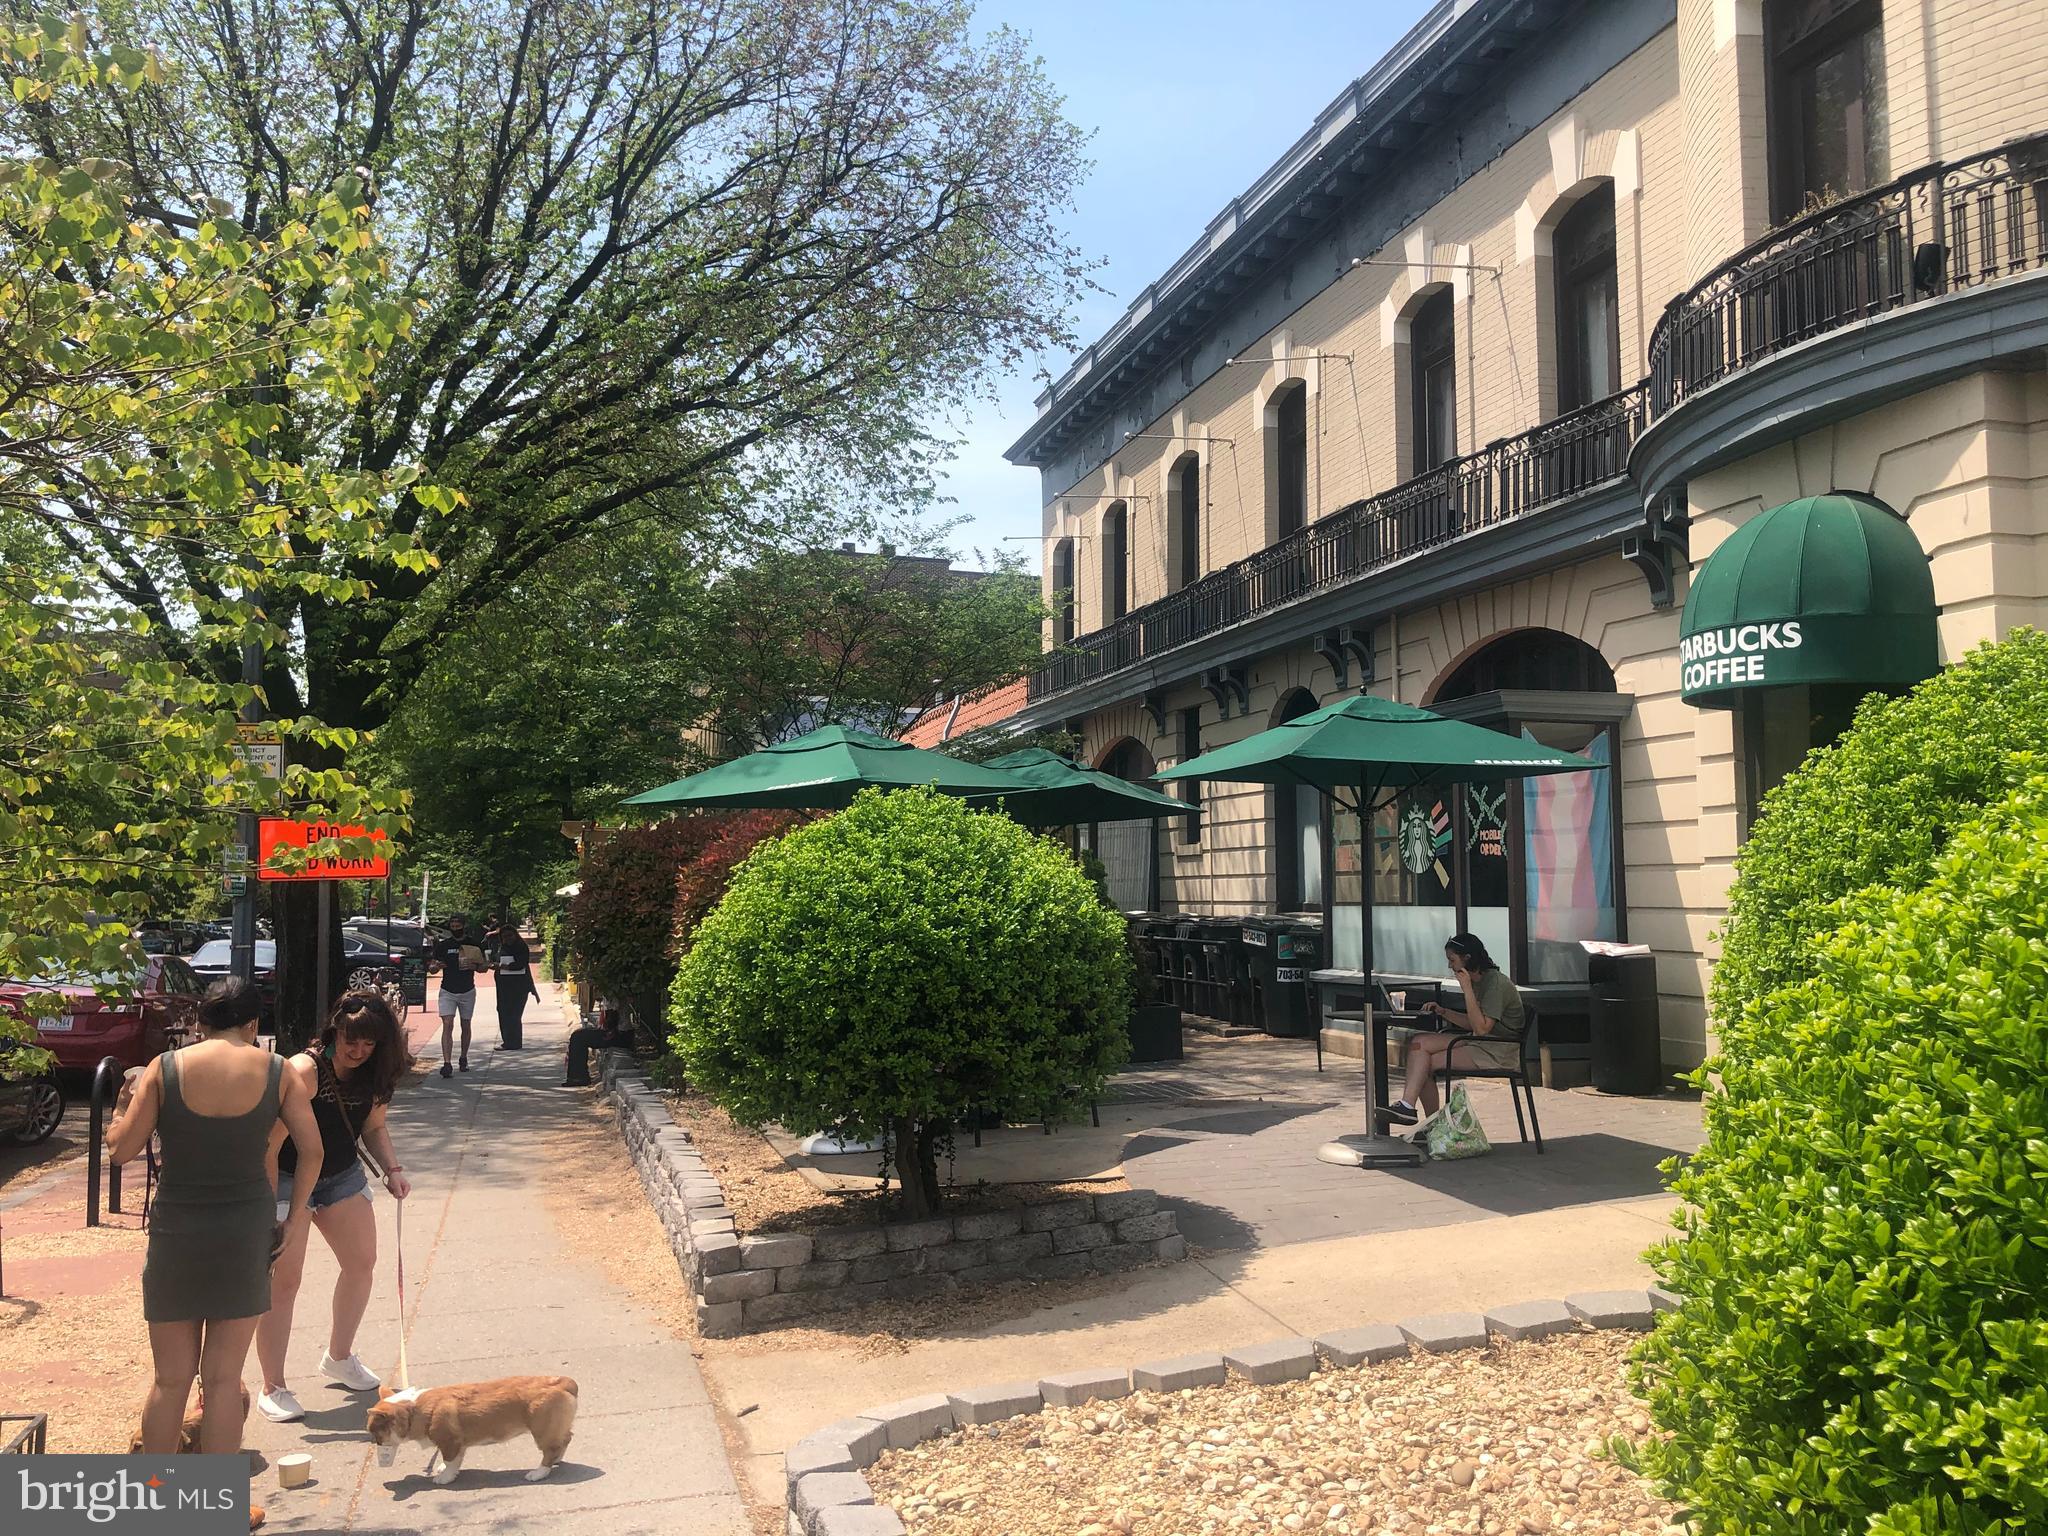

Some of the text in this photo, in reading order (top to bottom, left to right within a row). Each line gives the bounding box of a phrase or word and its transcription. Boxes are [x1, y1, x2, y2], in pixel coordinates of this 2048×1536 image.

[1681, 622, 1803, 665] TARBUCKS
[1684, 655, 1765, 691] COFFEE
[306, 826, 341, 845] END
[1479, 829, 1502, 841] MOBILE
[1479, 843, 1502, 857] ORDER
